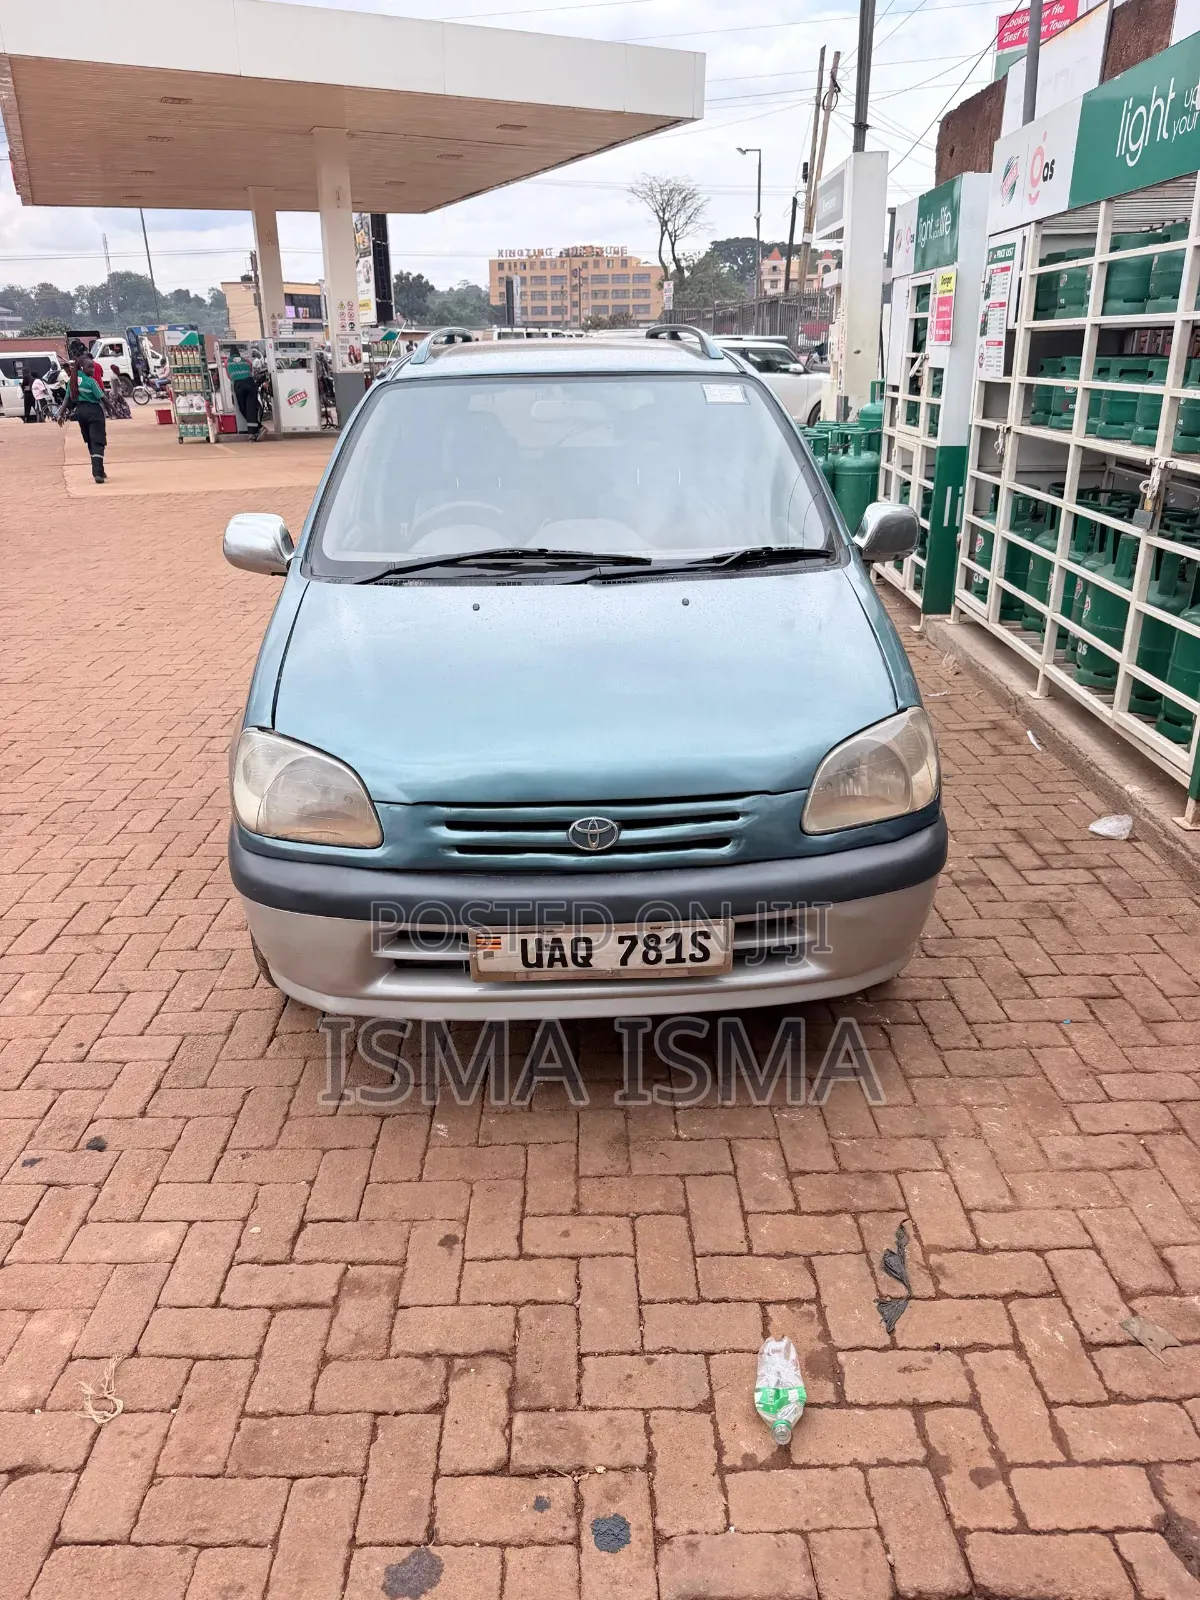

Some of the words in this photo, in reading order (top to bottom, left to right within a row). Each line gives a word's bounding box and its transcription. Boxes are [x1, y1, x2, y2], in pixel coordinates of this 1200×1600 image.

[1002, 30, 1021, 43] Best
[1049, 19, 1071, 32] Town
[1004, 13, 1030, 29] Lookin
[1051, 4, 1066, 16] the
[1115, 77, 1176, 167] light
[1171, 111, 1200, 144] your
[289, 391, 306, 404] RUBIS
[520, 936, 594, 969] UAQ
[617, 930, 712, 967] 781S
